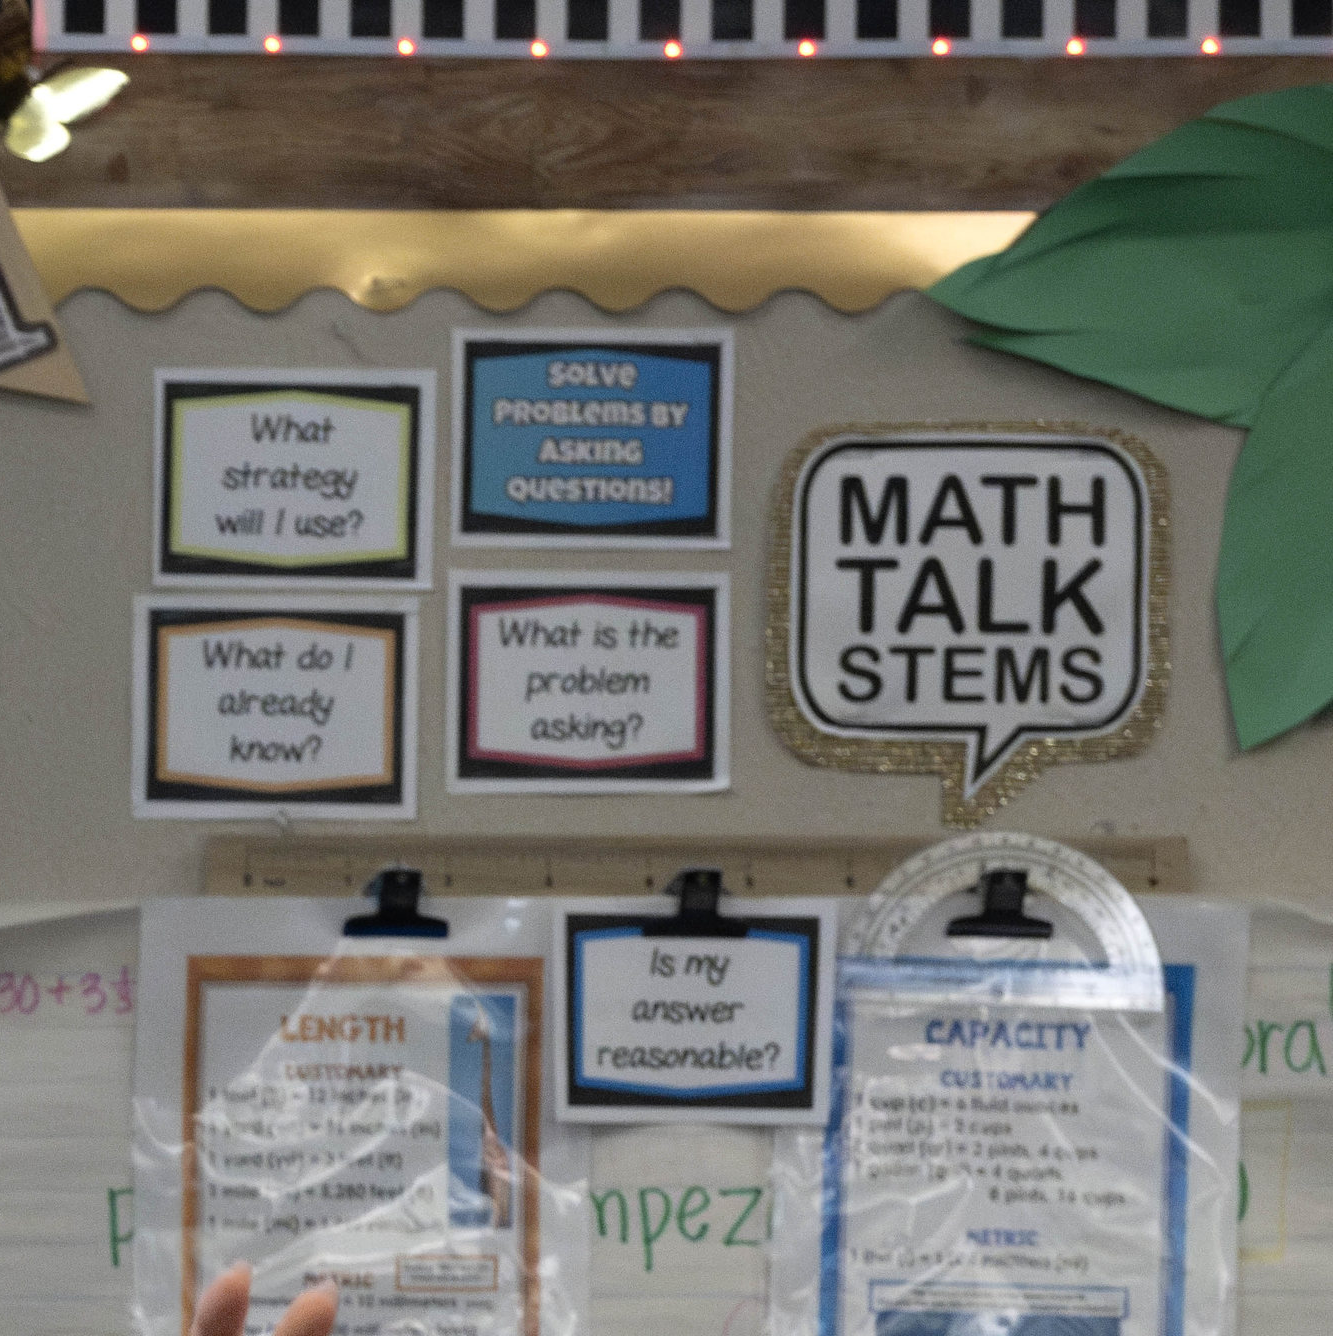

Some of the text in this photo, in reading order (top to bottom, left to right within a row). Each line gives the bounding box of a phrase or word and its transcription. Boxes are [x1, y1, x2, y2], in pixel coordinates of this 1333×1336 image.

[251, 412, 336, 443] What
[652, 402, 688, 427] BY
[222, 463, 359, 500] strategy
[215, 510, 365, 538] will I use?
[839, 473, 1106, 547] MATH
[835, 555, 1105, 636] TALK
[498, 617, 680, 650] What is the
[202, 638, 354, 672] What do I
[525, 666, 651, 702] problem
[837, 643, 1104, 704] STEMS
[217, 690, 335, 727] already
[530, 711, 644, 751] asking?
[230, 735, 323, 763] know?
[649, 946, 730, 987] Is my
[280, 1013, 407, 1044] LENGTH
[632, 999, 745, 1025] answer
[925, 1018, 1092, 1051] CAPACITY
[596, 1040, 781, 1072] reasonable?
[939, 1067, 1074, 1092] CUSTOMARY
